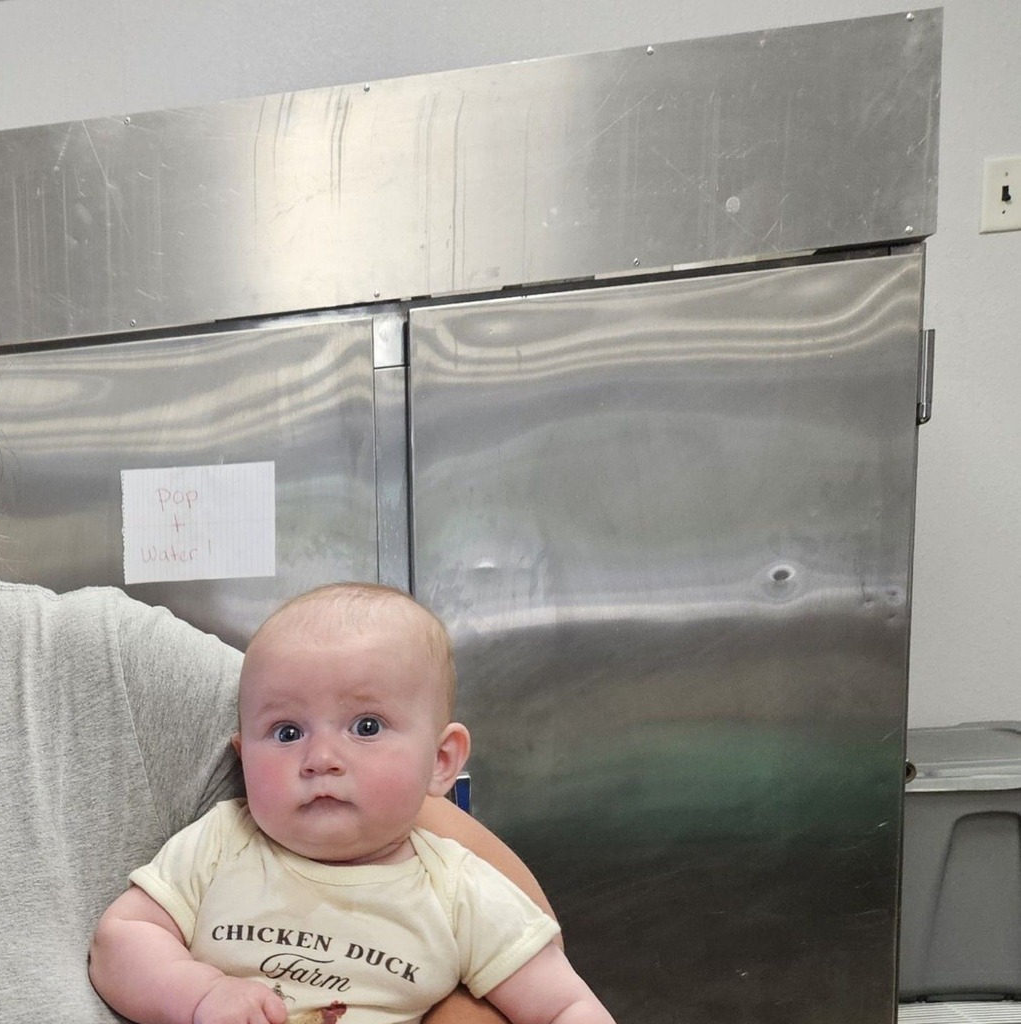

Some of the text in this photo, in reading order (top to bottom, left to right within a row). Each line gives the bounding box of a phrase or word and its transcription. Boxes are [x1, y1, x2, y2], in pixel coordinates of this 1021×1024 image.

[211, 924, 421, 984] CHICKEN DUCK
[259, 952, 352, 993] Farm
